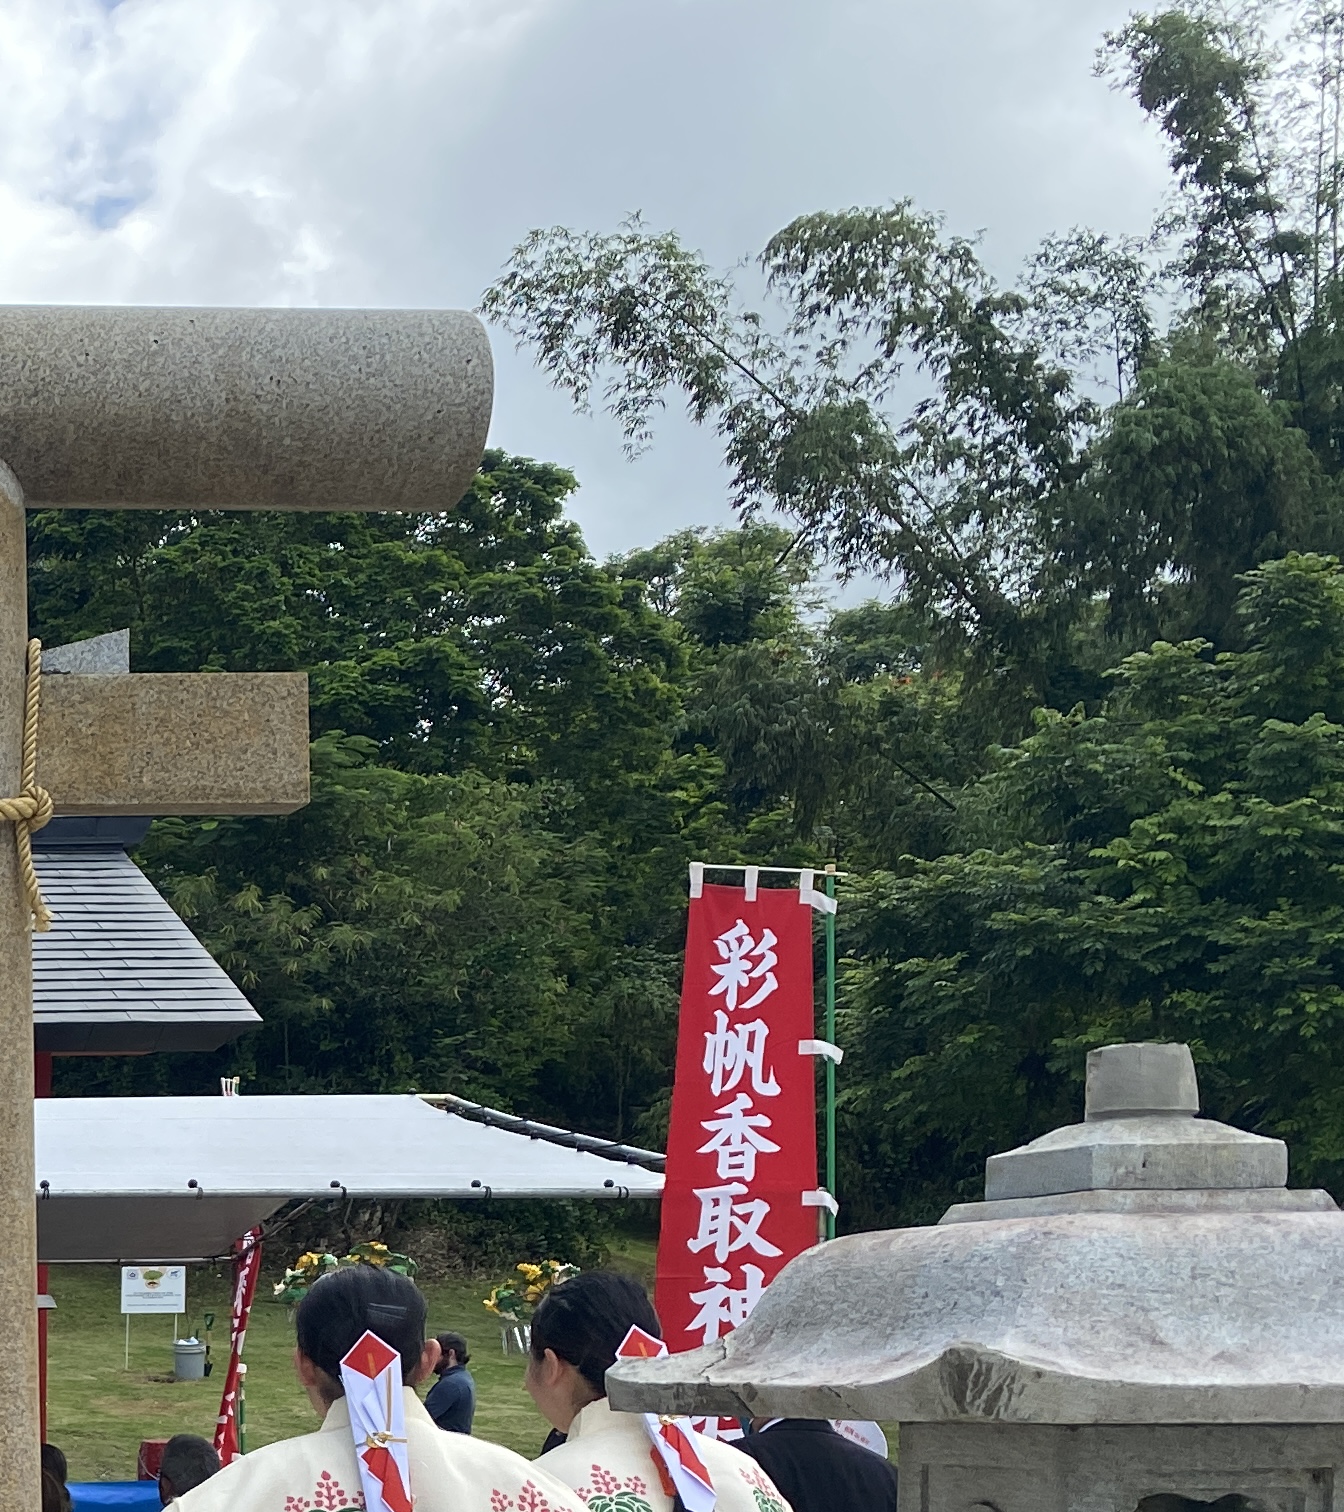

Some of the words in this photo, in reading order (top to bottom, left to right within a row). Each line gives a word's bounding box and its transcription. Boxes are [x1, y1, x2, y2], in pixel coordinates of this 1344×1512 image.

[685, 918, 784, 1345] 彩帆香取神
